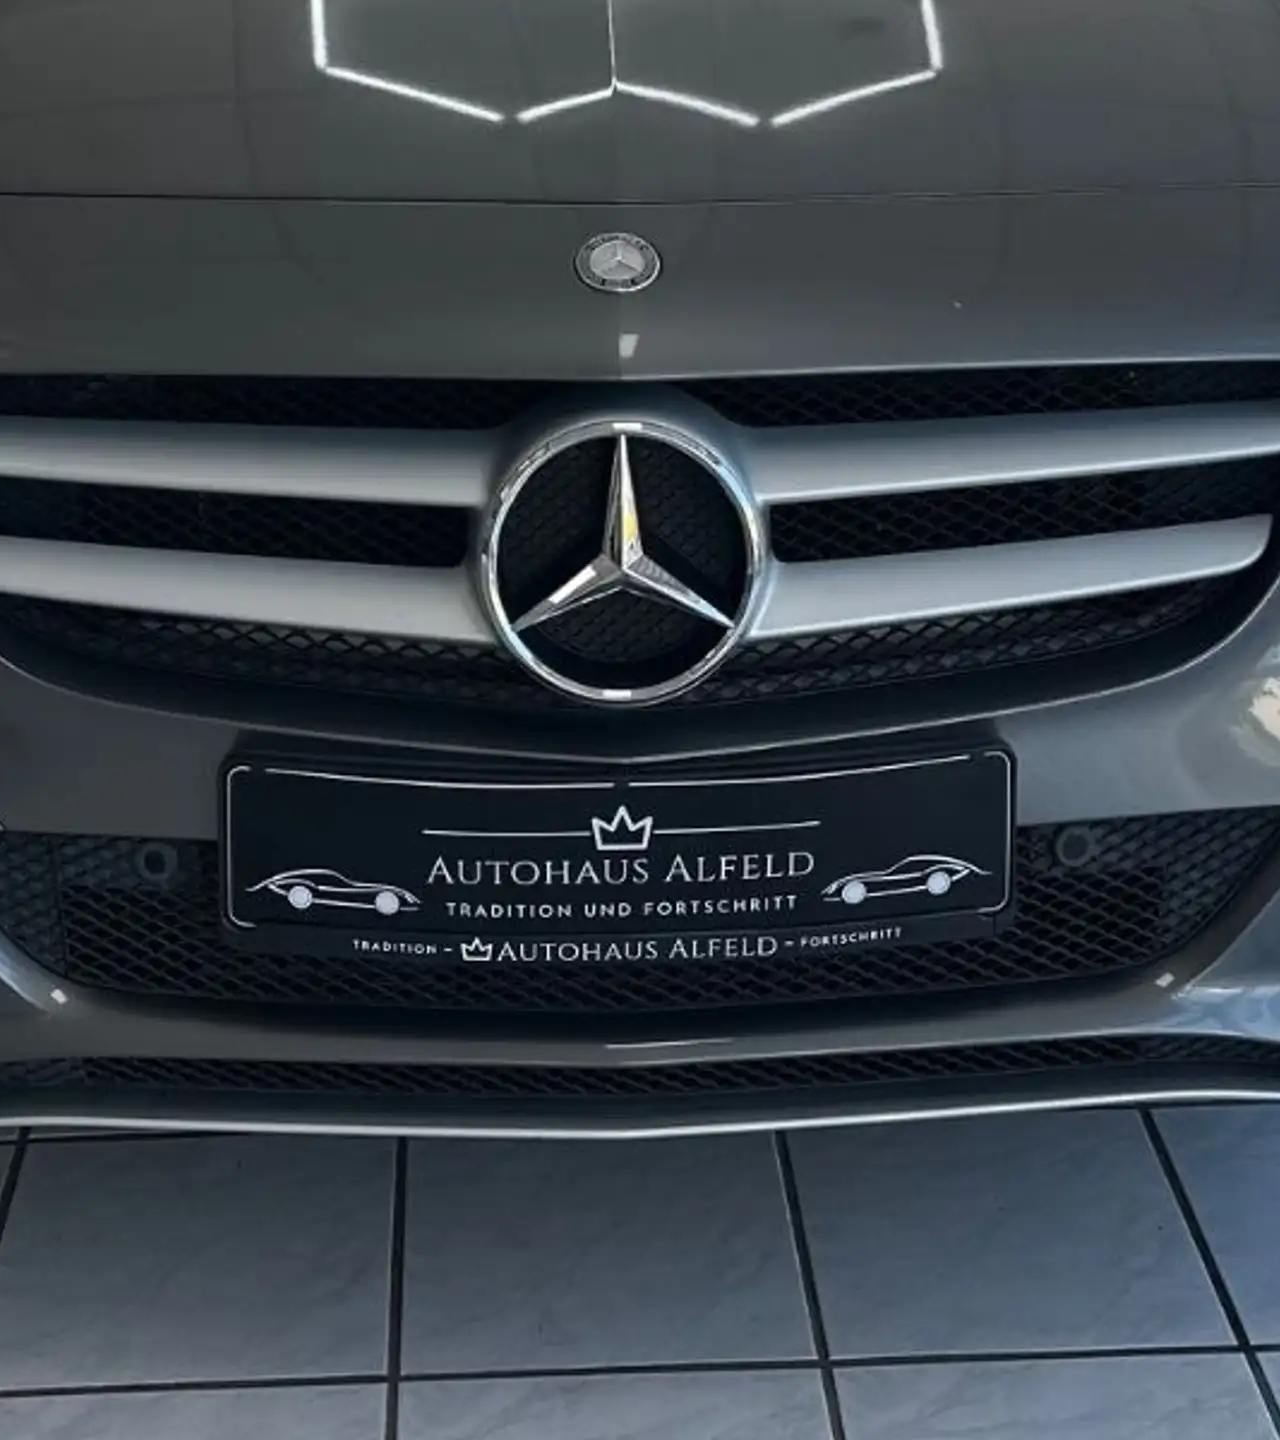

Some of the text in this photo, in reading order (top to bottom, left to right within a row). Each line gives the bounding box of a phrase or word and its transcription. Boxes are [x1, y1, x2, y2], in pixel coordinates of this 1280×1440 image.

[427, 851, 815, 885] AUTOHAUS ALFELD
[445, 894, 797, 919] TRADITION UND FORTSCHRITT
[352, 938, 437, 954] TRADITION
[496, 940, 659, 961] AUTOHAUS
[669, 936, 778, 959] ALFELD
[800, 926, 902, 948] FORTSCHRITT
